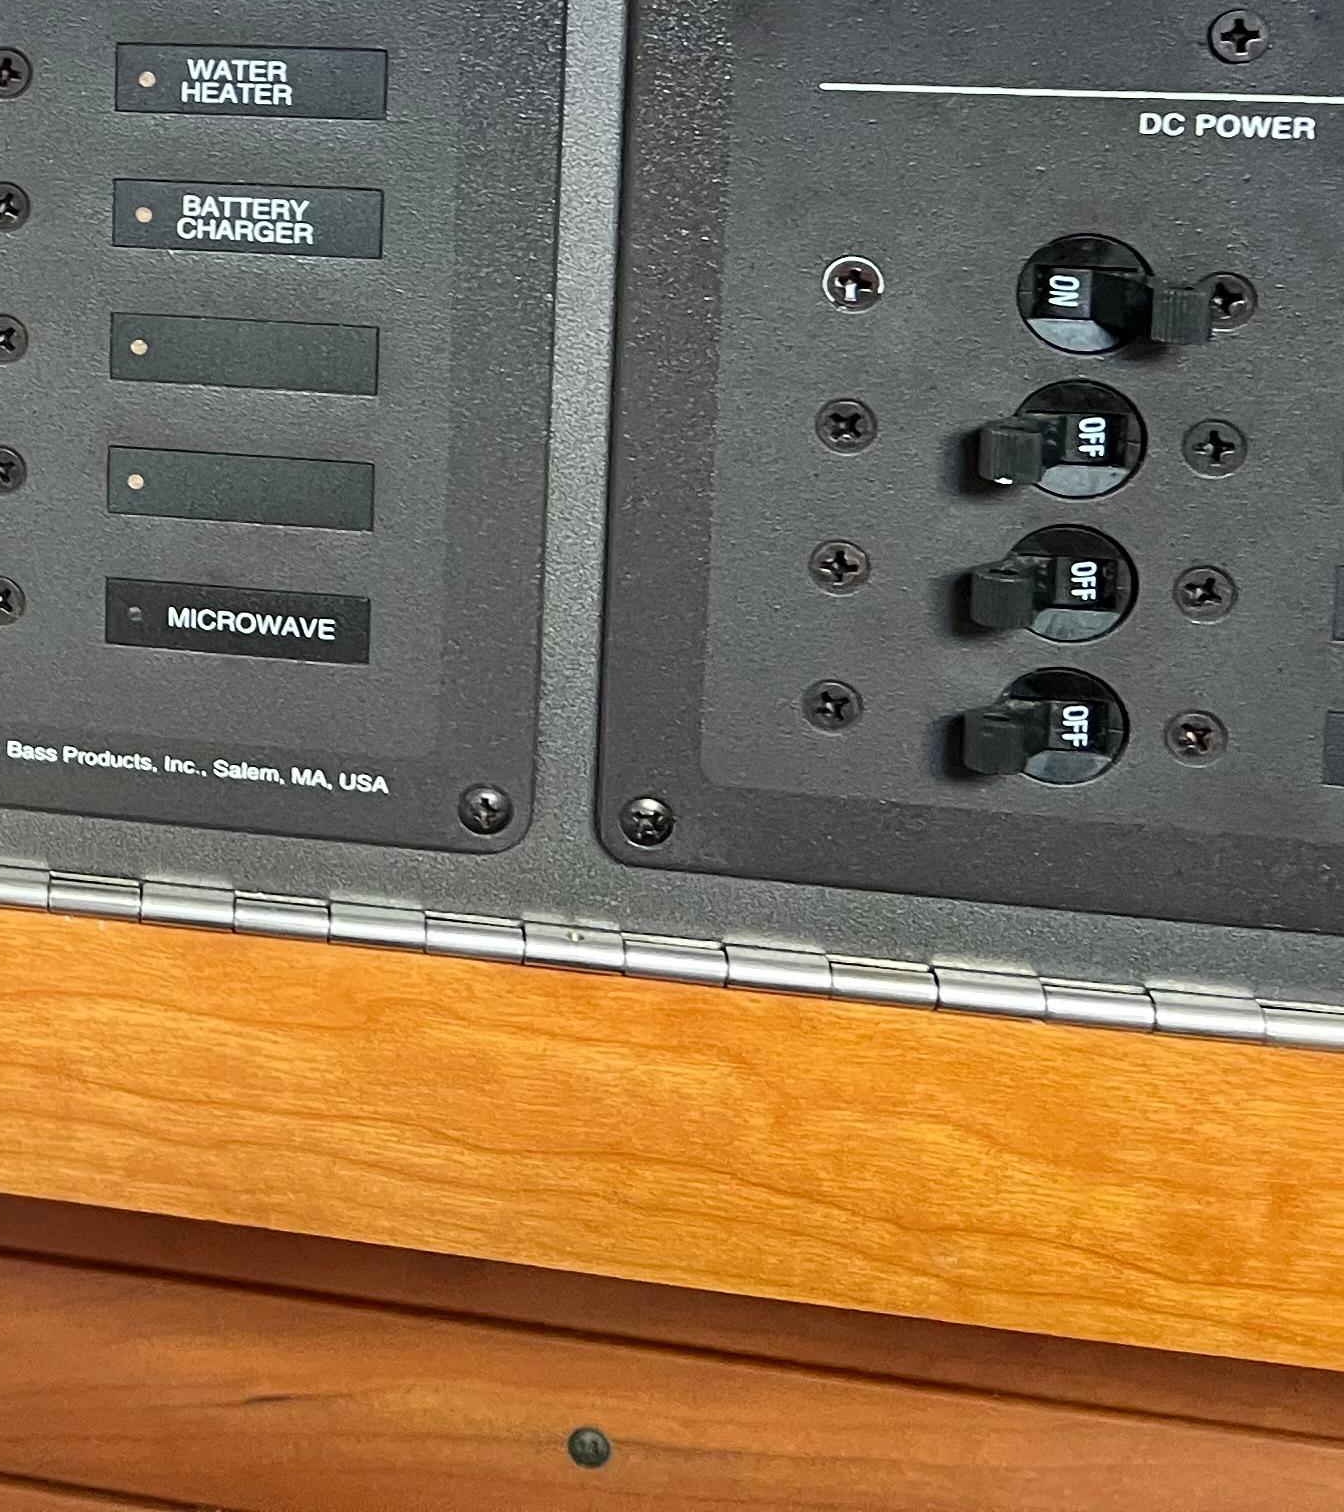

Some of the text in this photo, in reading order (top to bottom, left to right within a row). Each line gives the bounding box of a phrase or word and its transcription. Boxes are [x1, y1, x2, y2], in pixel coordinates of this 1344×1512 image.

[186, 59, 288, 83] WATER
[180, 81, 293, 106] HEATER
[1139, 112, 1316, 141] DC POWER
[182, 194, 310, 221] BATTERY
[176, 218, 314, 245] CHARGER
[1048, 275, 1080, 308] ON
[1078, 416, 1107, 459] OFF
[1070, 560, 1098, 601] OFF
[166, 605, 336, 641] MICROWAVE
[1062, 704, 1089, 749] OFF
[6, 740, 390, 794] Bass Products, Inc., Salem, MA, USA
